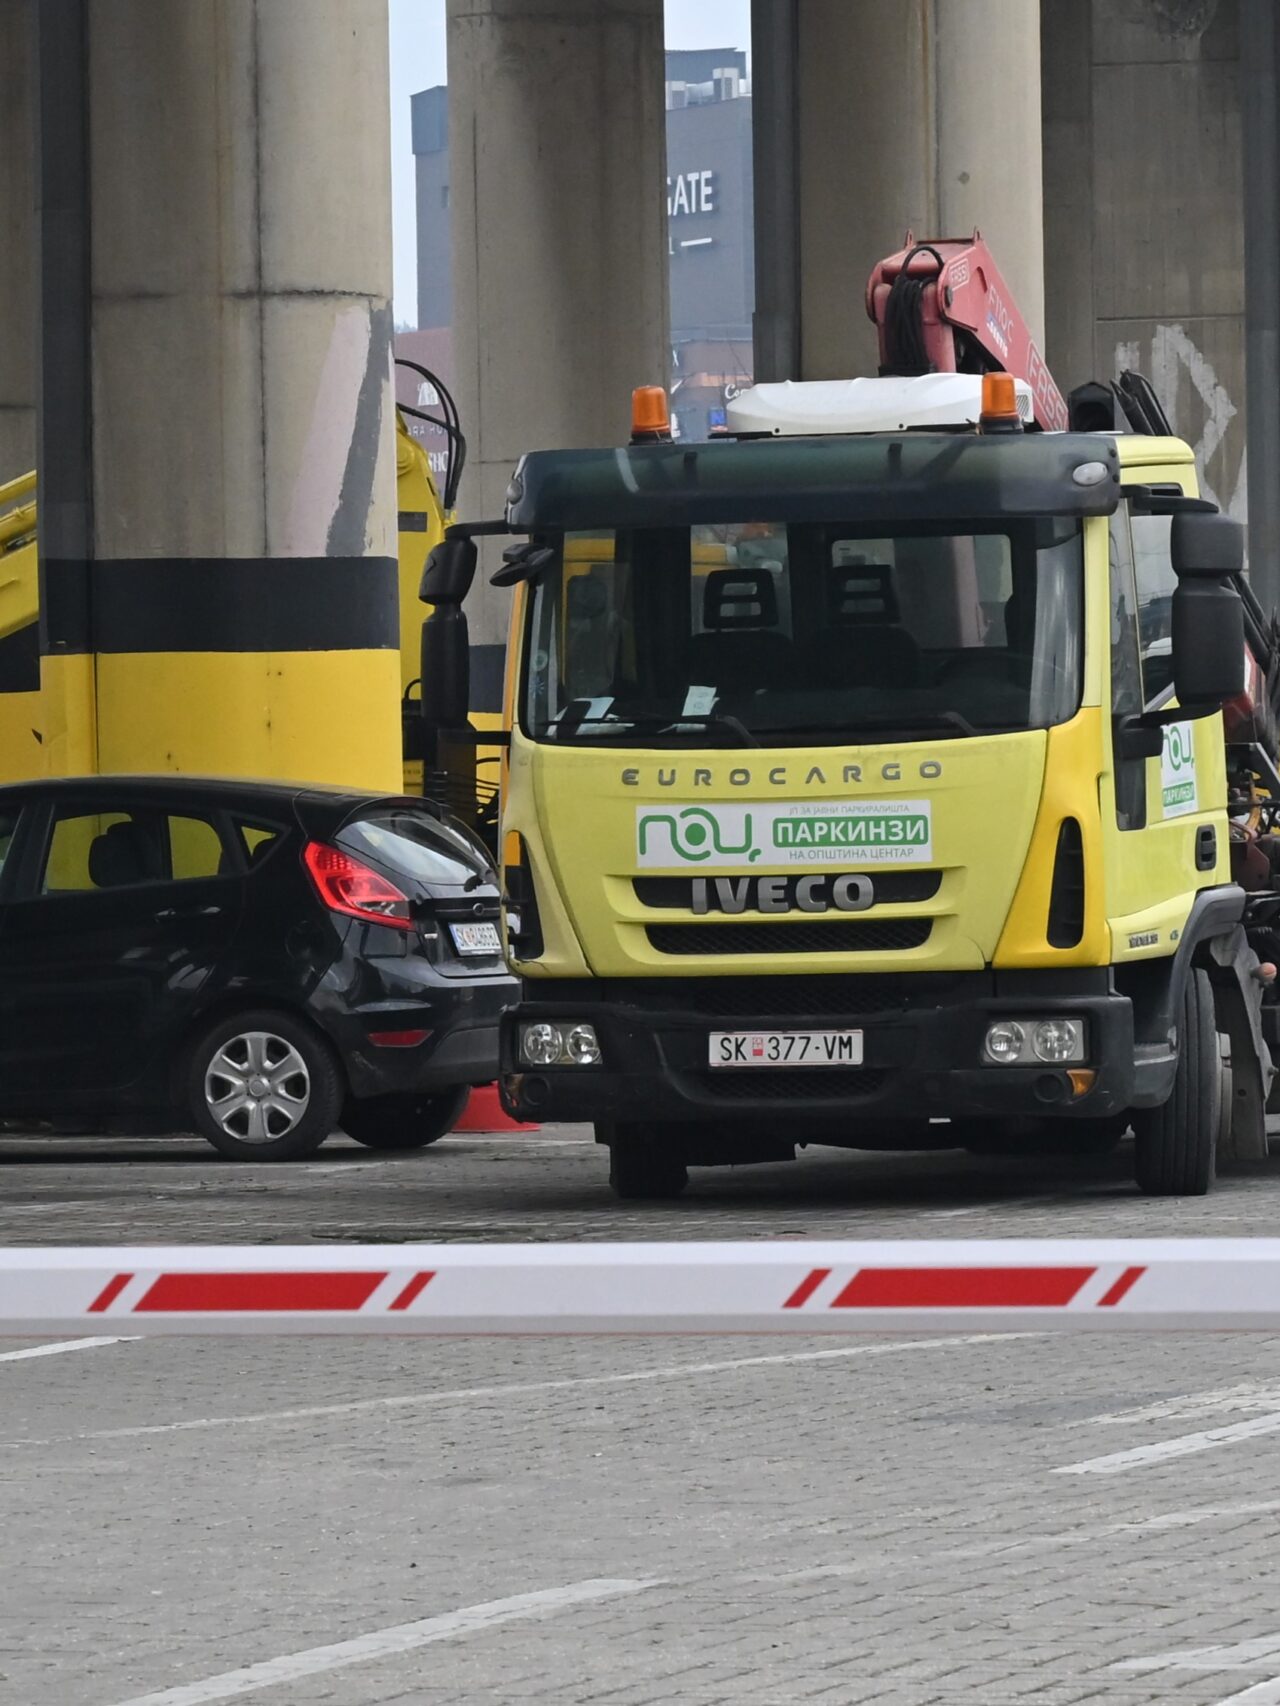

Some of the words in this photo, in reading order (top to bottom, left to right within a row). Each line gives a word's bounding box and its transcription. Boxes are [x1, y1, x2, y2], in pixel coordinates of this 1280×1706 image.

[621, 761, 942, 786] EUROCARGO
[777, 819, 925, 844] ПАРКИНЗИ
[789, 850, 805, 860] НА
[807, 849, 867, 859] ОПШТИНА
[870, 847, 914, 860] ЦЕНТАР
[691, 874, 874, 914] IVECO
[720, 1036, 747, 1061] SK
[767, 1035, 853, 1061] 377-VM
